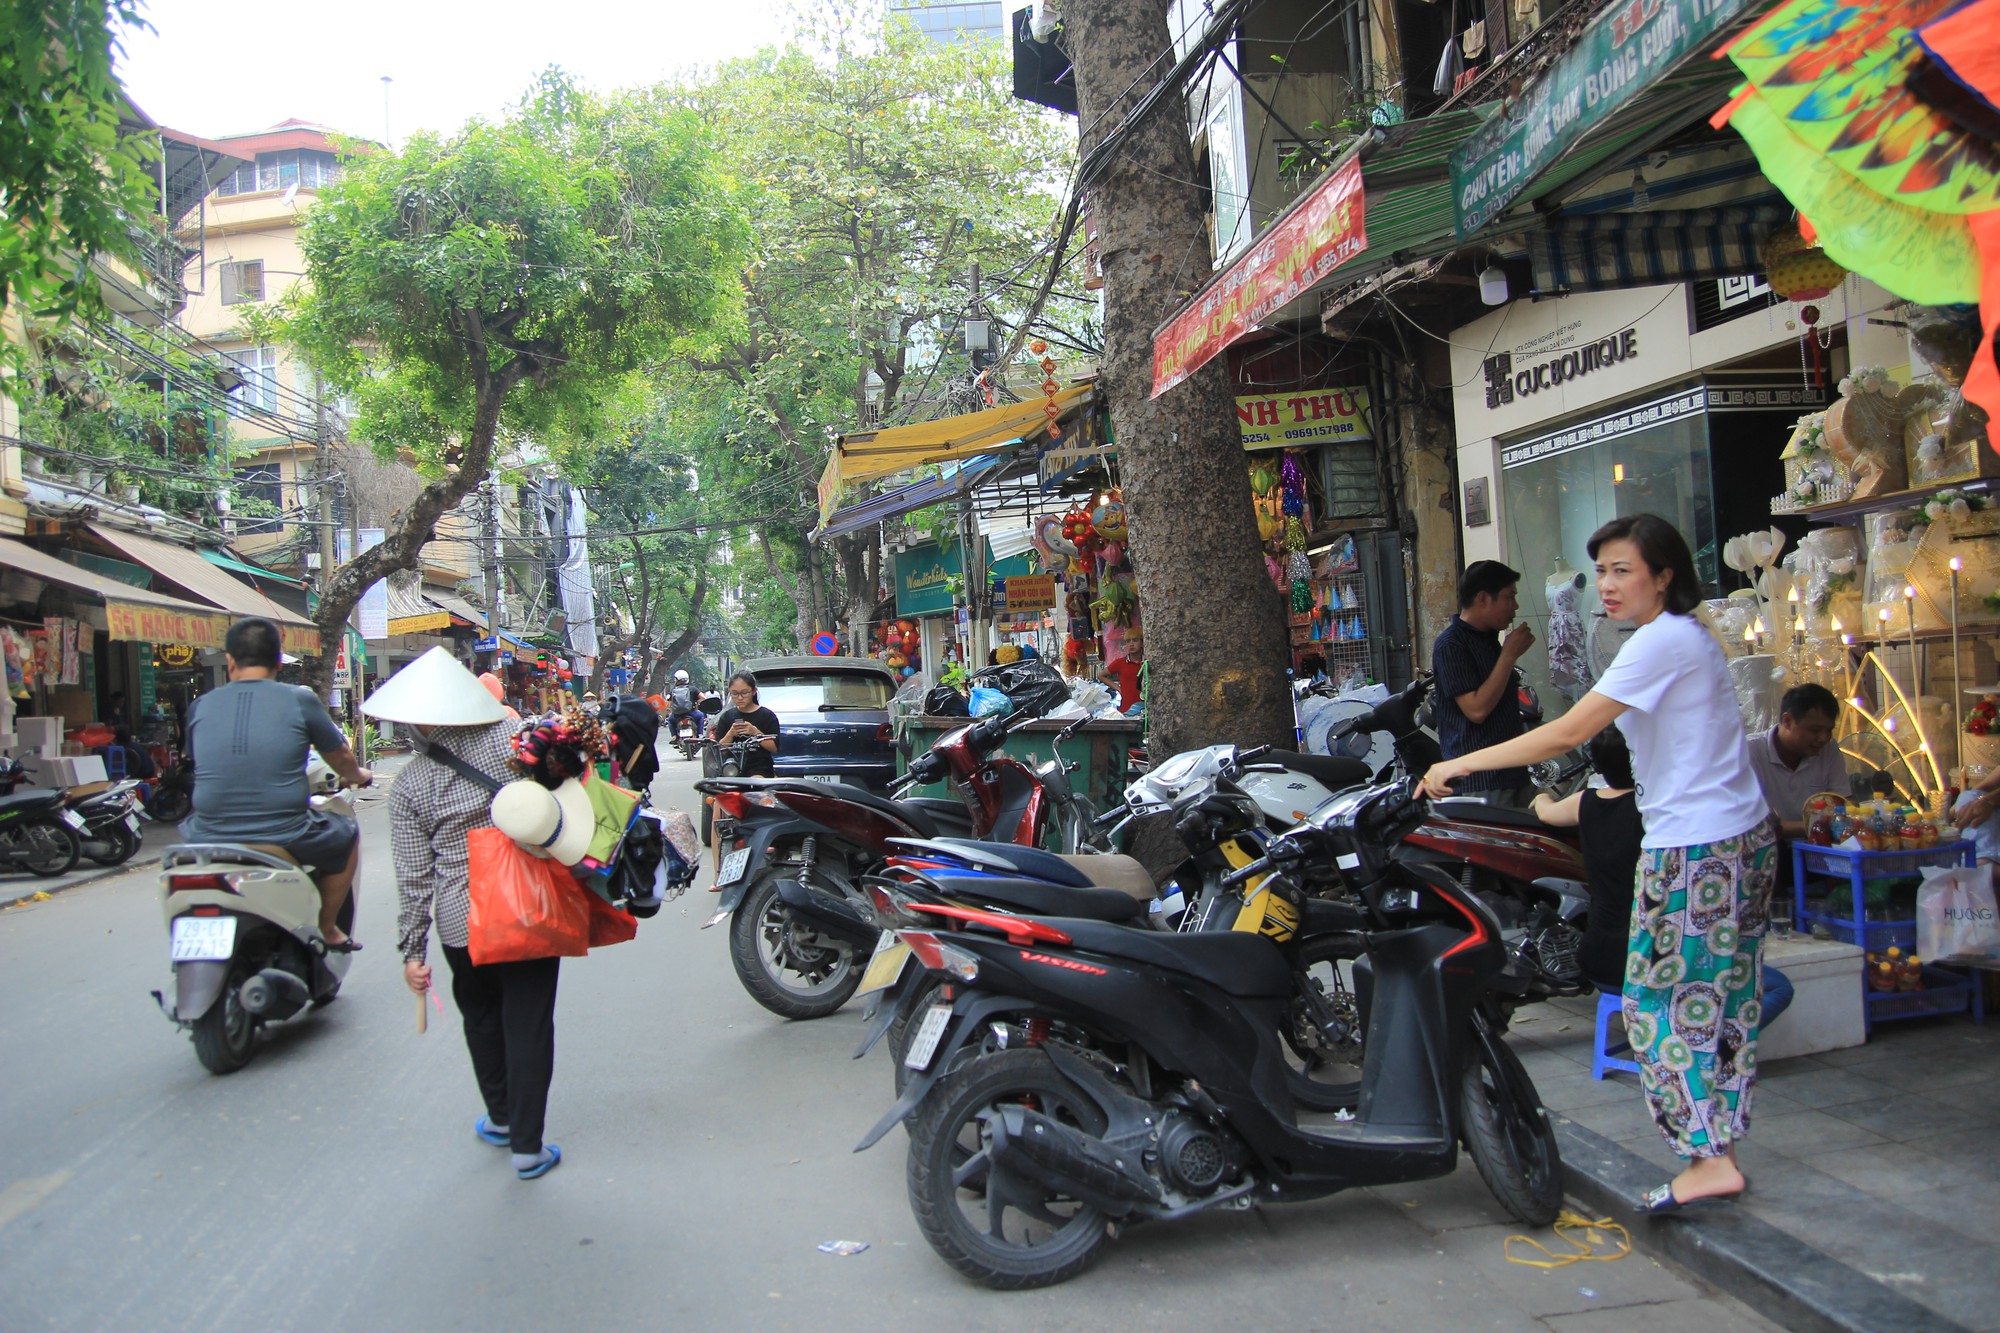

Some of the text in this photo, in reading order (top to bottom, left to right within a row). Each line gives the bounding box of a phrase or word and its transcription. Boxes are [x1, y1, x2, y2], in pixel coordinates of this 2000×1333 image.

[1585, 46, 1639, 109] BÓNG
[1524, 339, 1538, 350] CÔNG
[1288, 388, 1360, 423] THƯ
[1285, 422, 1354, 440] 0969157988
[111, 608, 137, 637] 55
[141, 611, 188, 641] HÀNG
[1020, 950, 1108, 976] VISION
